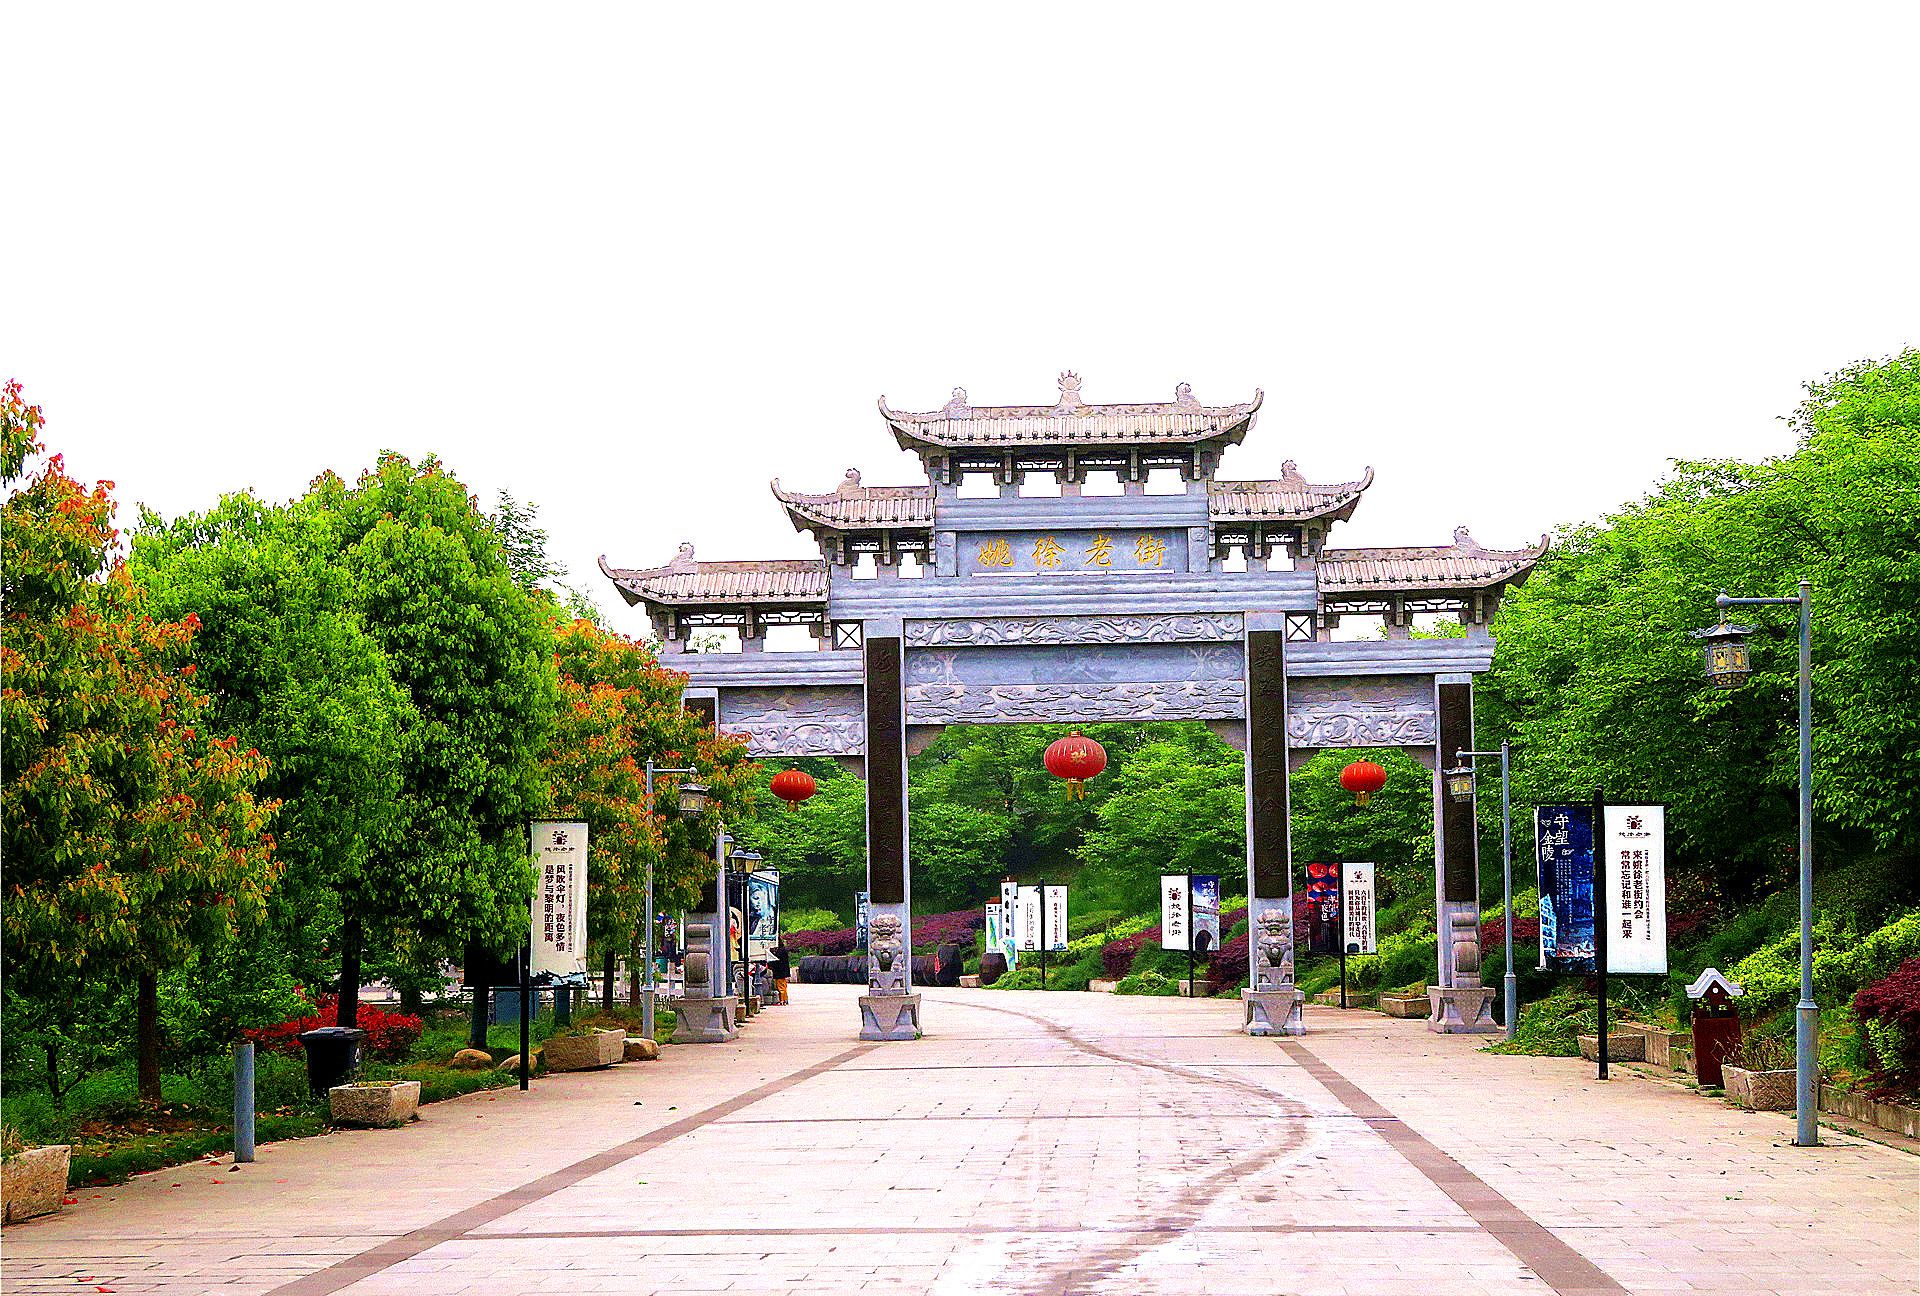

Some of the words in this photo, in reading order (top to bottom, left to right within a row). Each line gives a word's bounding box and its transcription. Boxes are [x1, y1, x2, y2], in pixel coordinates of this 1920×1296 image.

[977, 534, 1168, 568] 姚徐老街
[1540, 829, 1555, 861] 金陵
[1554, 813, 1570, 845] 守望
[544, 864, 554, 942] 是梦与黎明的距离
[1621, 850, 1632, 938] 常常忘记和谁一起来
